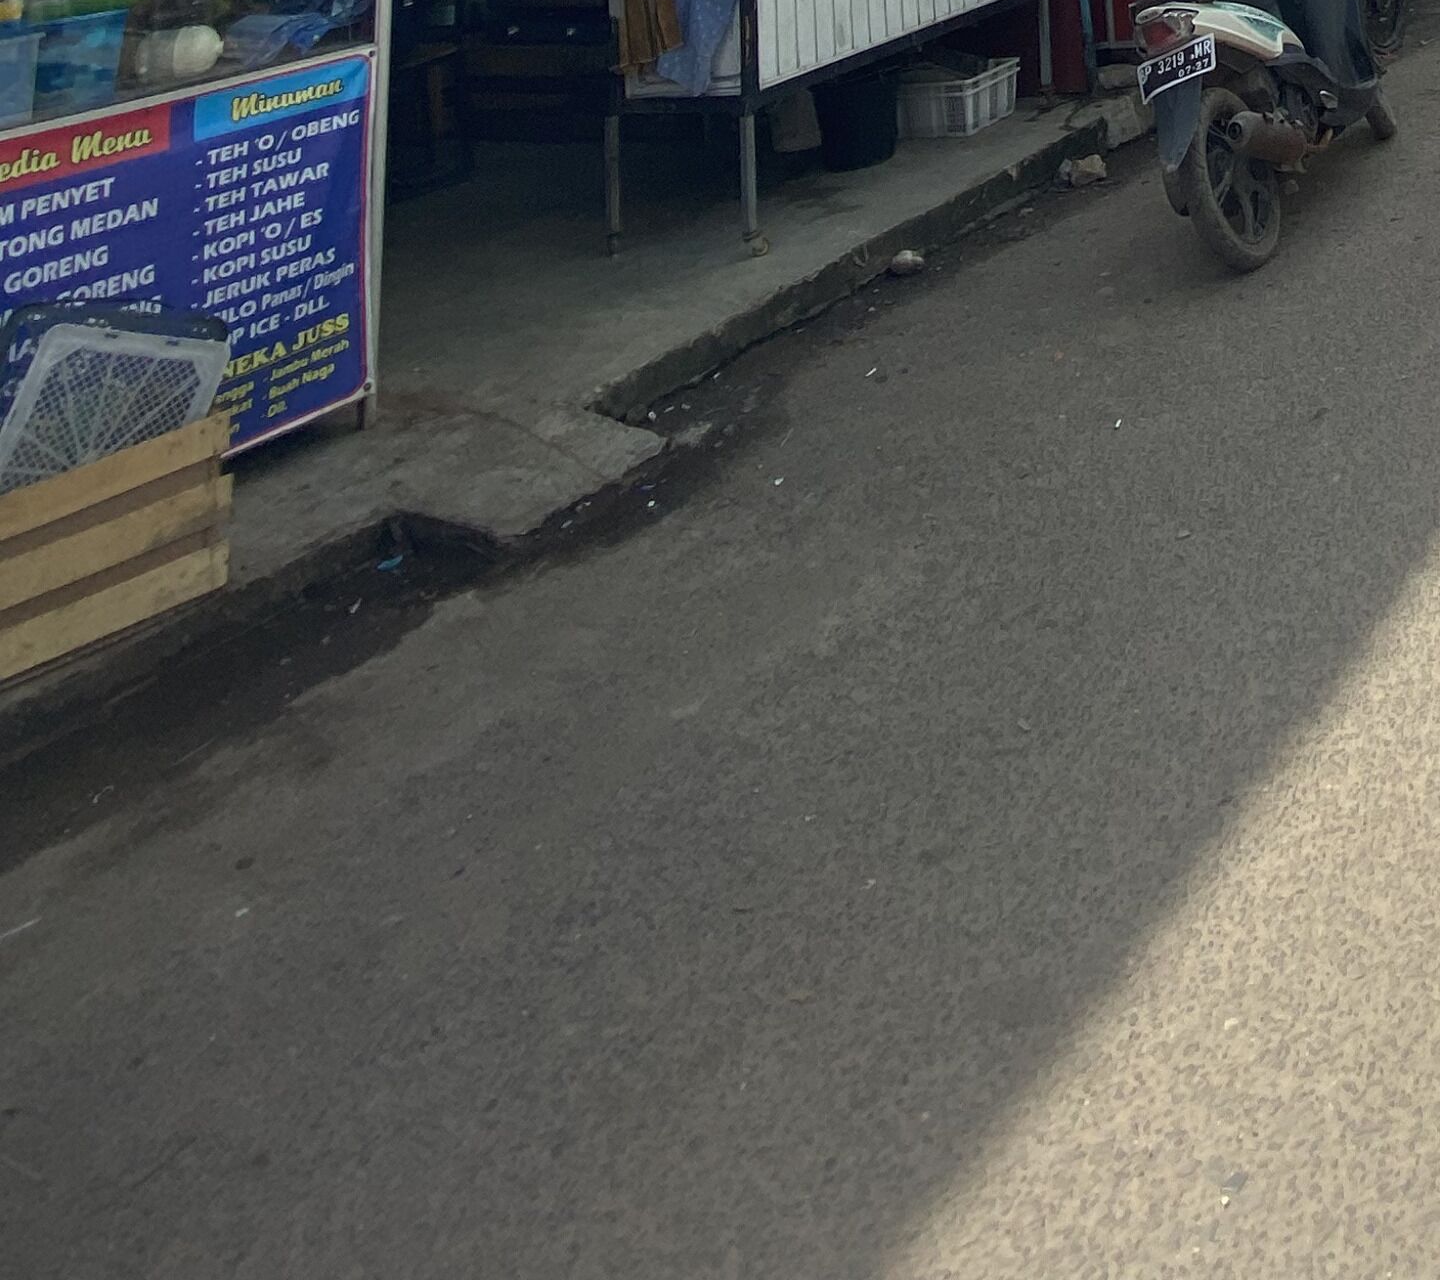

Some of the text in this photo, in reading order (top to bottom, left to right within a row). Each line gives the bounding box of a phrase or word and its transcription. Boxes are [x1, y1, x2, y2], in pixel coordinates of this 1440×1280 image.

[1158, 51, 1185, 75] 3219
[232, 79, 344, 123] Minuman
[71, 127, 153, 164] Menu
[207, 140, 249, 165] TEH
[291, 109, 360, 141] OBENG
[205, 162, 330, 213] TEH TAWAR
[206, 146, 302, 189] TEH SUSU
[21, 176, 116, 221] PENYET
[70, 198, 159, 241] MEDAN
[204, 191, 305, 236] TEH JAHE
[203, 230, 256, 260] KOPI
[300, 208, 323, 230] ES
[4, 245, 109, 295] GORENG
[202, 271, 270, 309] JERUK
[276, 247, 336, 282] PERAS
[203, 234, 312, 284] KOPI SUSU
[250, 313, 281, 338] ICE
[293, 295, 331, 321] DLL
[292, 313, 350, 351] JUSS
[301, 363, 336, 384] Naga
